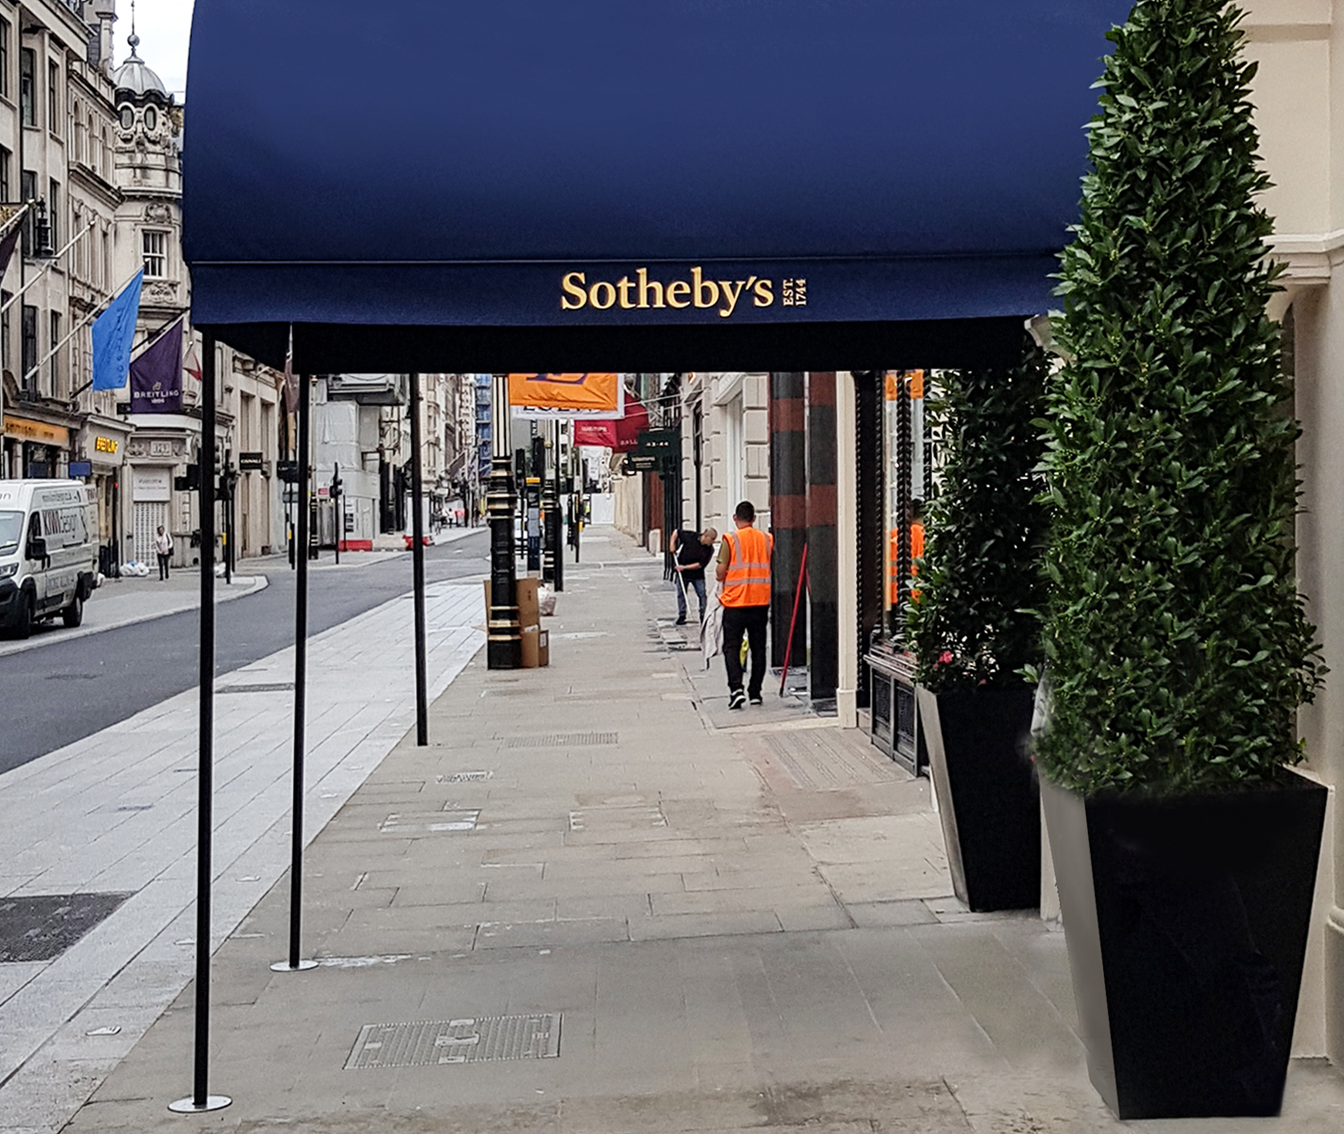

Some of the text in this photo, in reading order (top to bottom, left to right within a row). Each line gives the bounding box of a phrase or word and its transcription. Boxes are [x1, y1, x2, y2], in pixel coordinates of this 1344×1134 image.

[560, 266, 775, 318] Sotheby's
[782, 278, 795, 307] EST.
[795, 278, 807, 307] 1744
[133, 389, 180, 399] BREITLING
